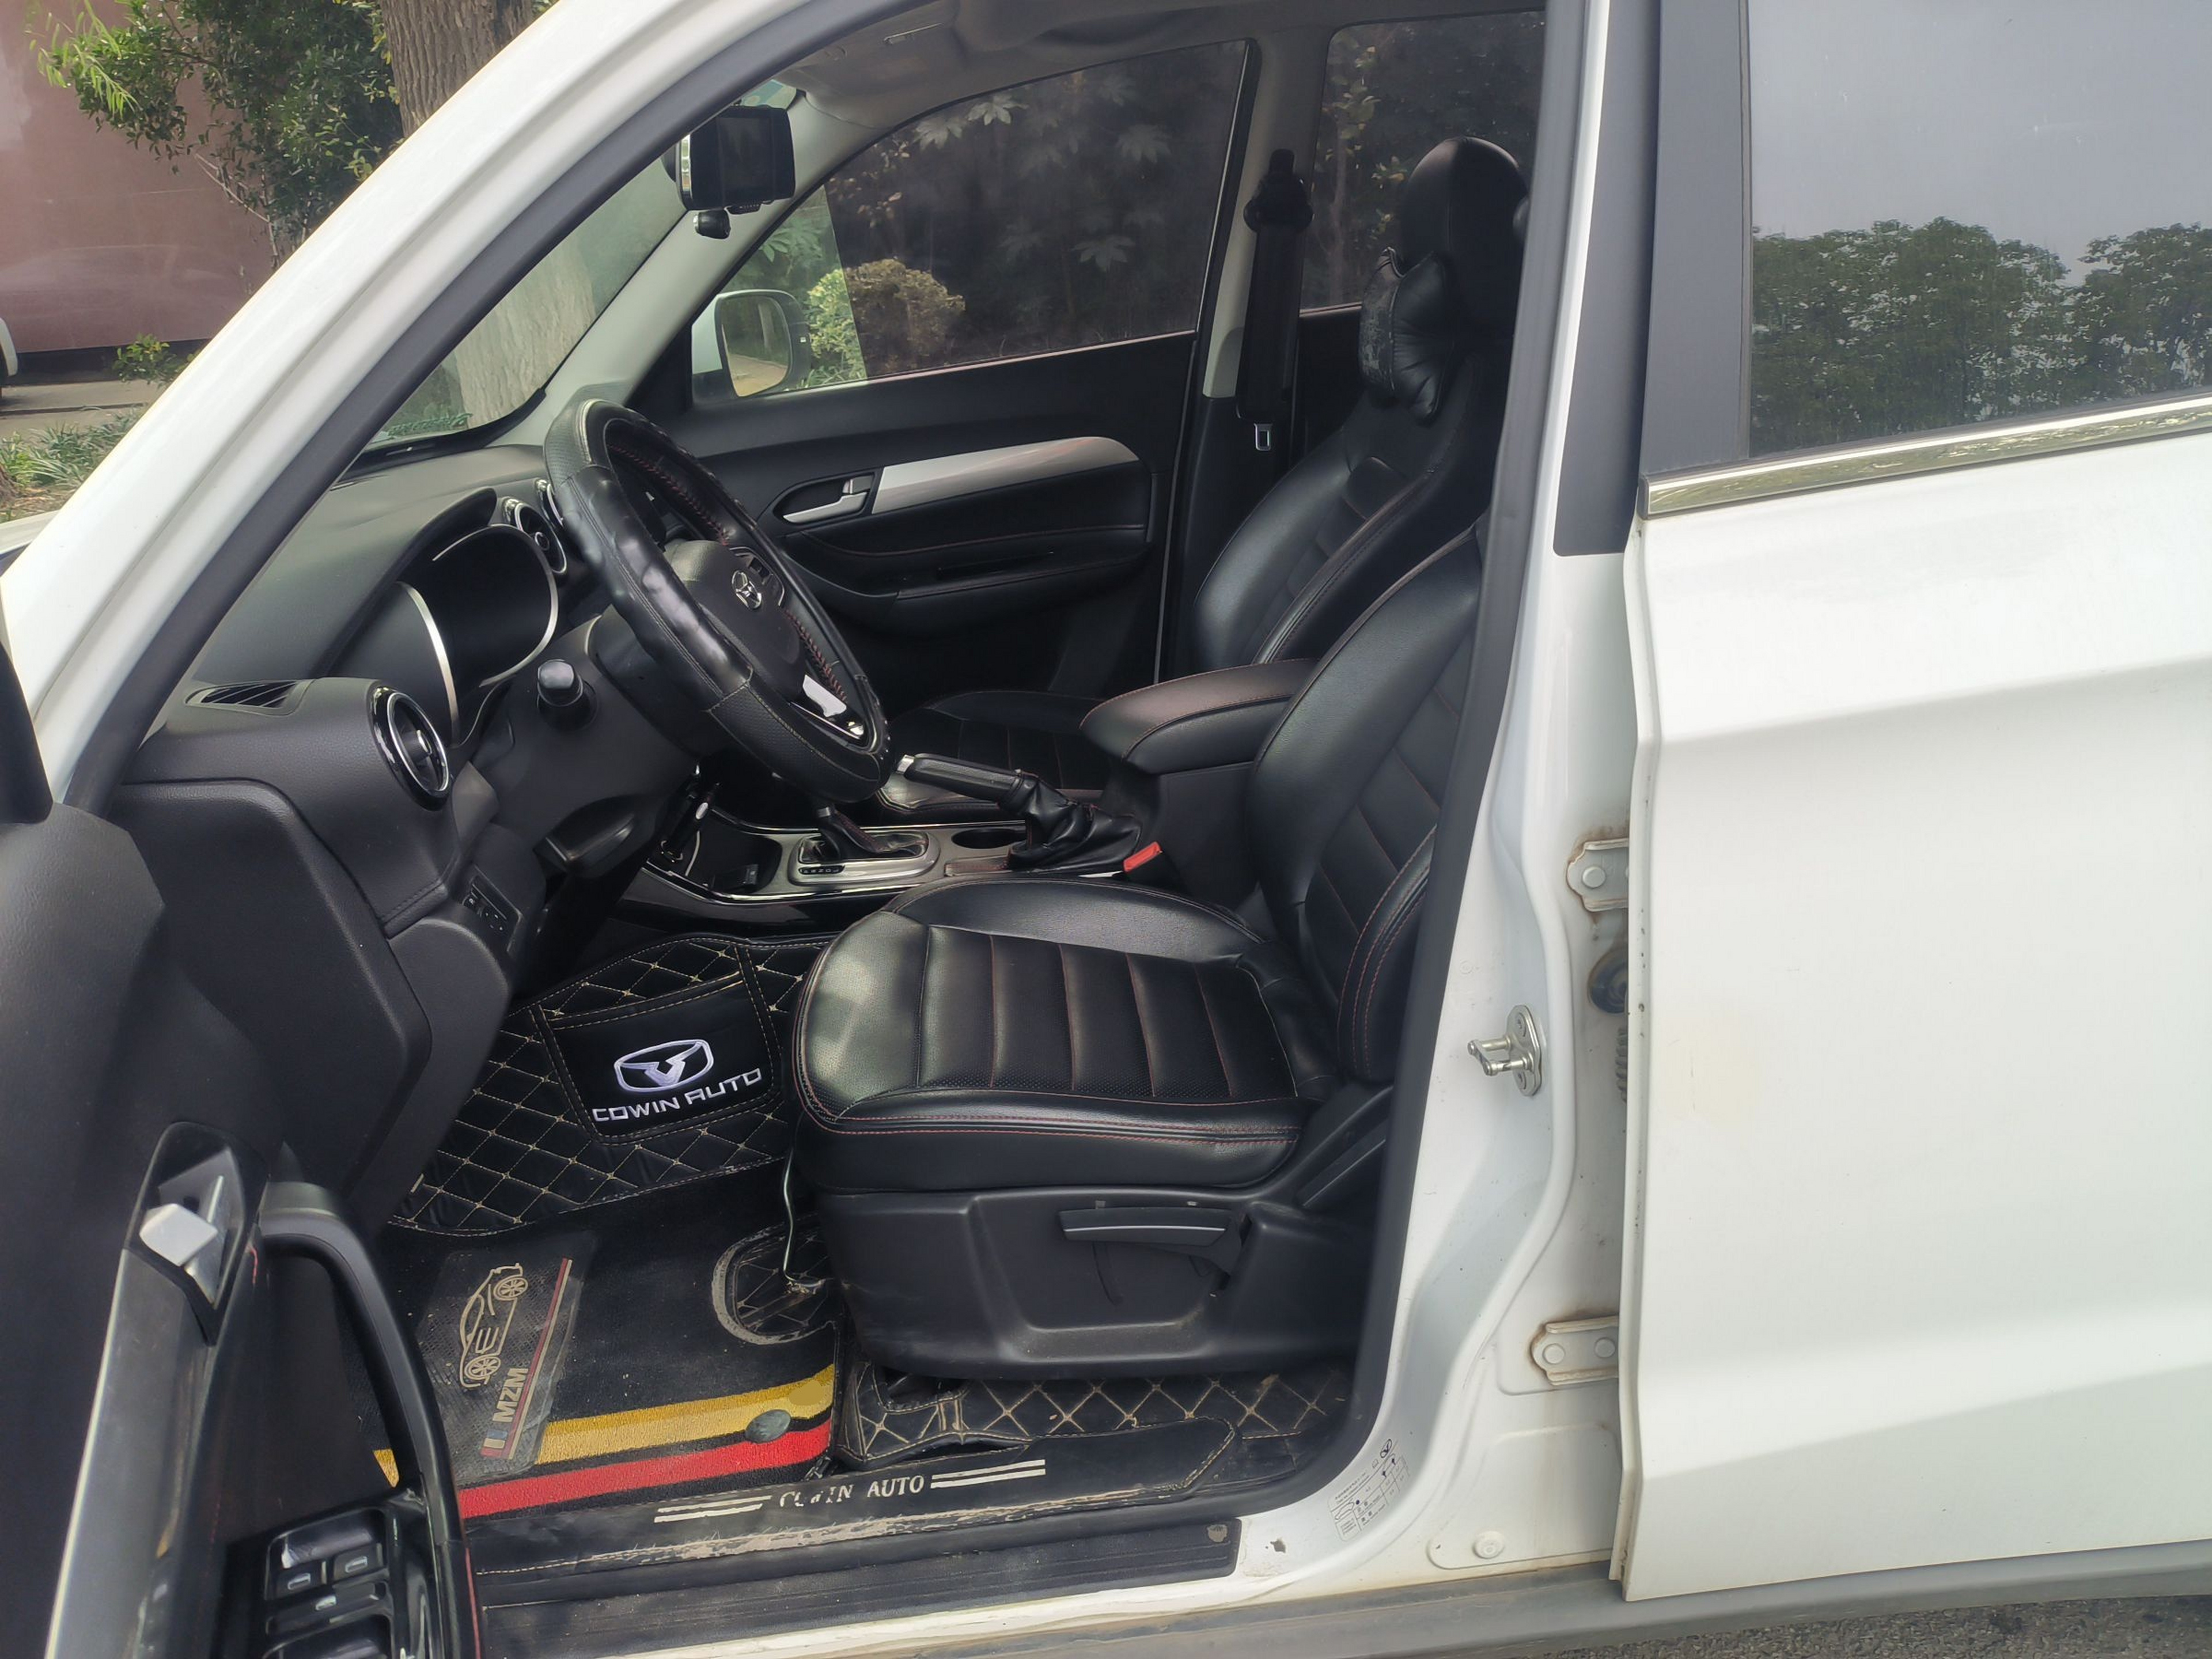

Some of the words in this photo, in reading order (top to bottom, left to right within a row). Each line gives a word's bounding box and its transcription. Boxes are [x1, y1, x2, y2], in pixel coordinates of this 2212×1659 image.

[592, 1097, 680, 1122] COWIN
[685, 1067, 762, 1104] AUTO
[493, 1368, 529, 1423] MZM
[867, 1475, 925, 1498] AUTO
